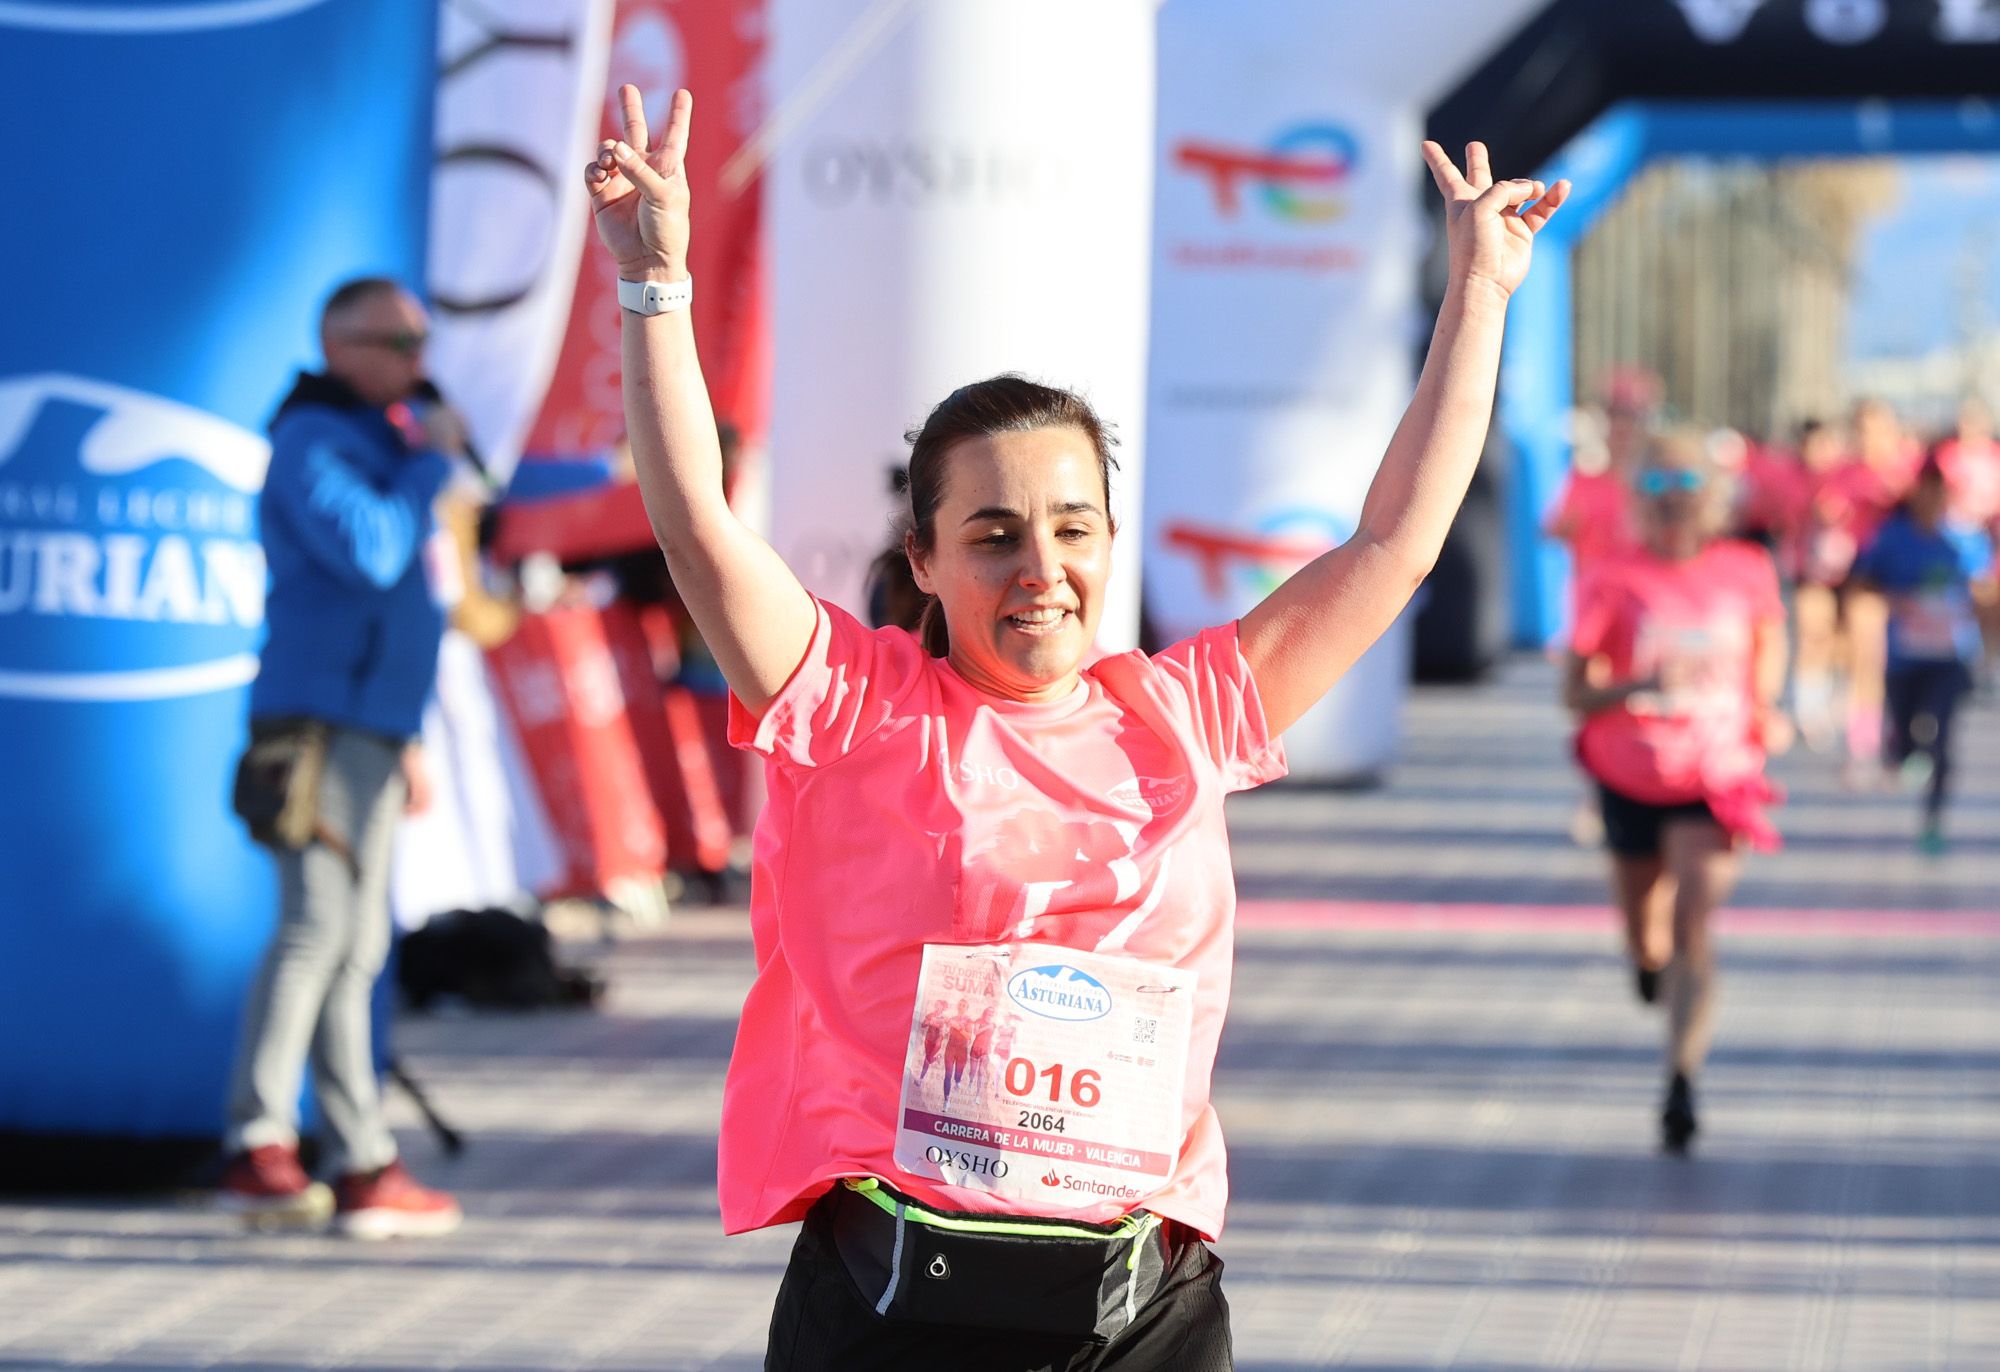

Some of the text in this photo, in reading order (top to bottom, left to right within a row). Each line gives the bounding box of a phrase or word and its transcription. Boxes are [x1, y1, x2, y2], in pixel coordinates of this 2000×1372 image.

[943, 975, 995, 997] SUMA
[1015, 978, 1103, 1012] ASTURIANA
[1005, 1057, 1101, 1108] 016
[1018, 1110, 1066, 1134] 2064
[934, 1120, 1141, 1168] CARRERA DE LA MUJER VALENCIA
[926, 1145, 1009, 1179] OYSHO
[1063, 1175, 1141, 1198] Santander
